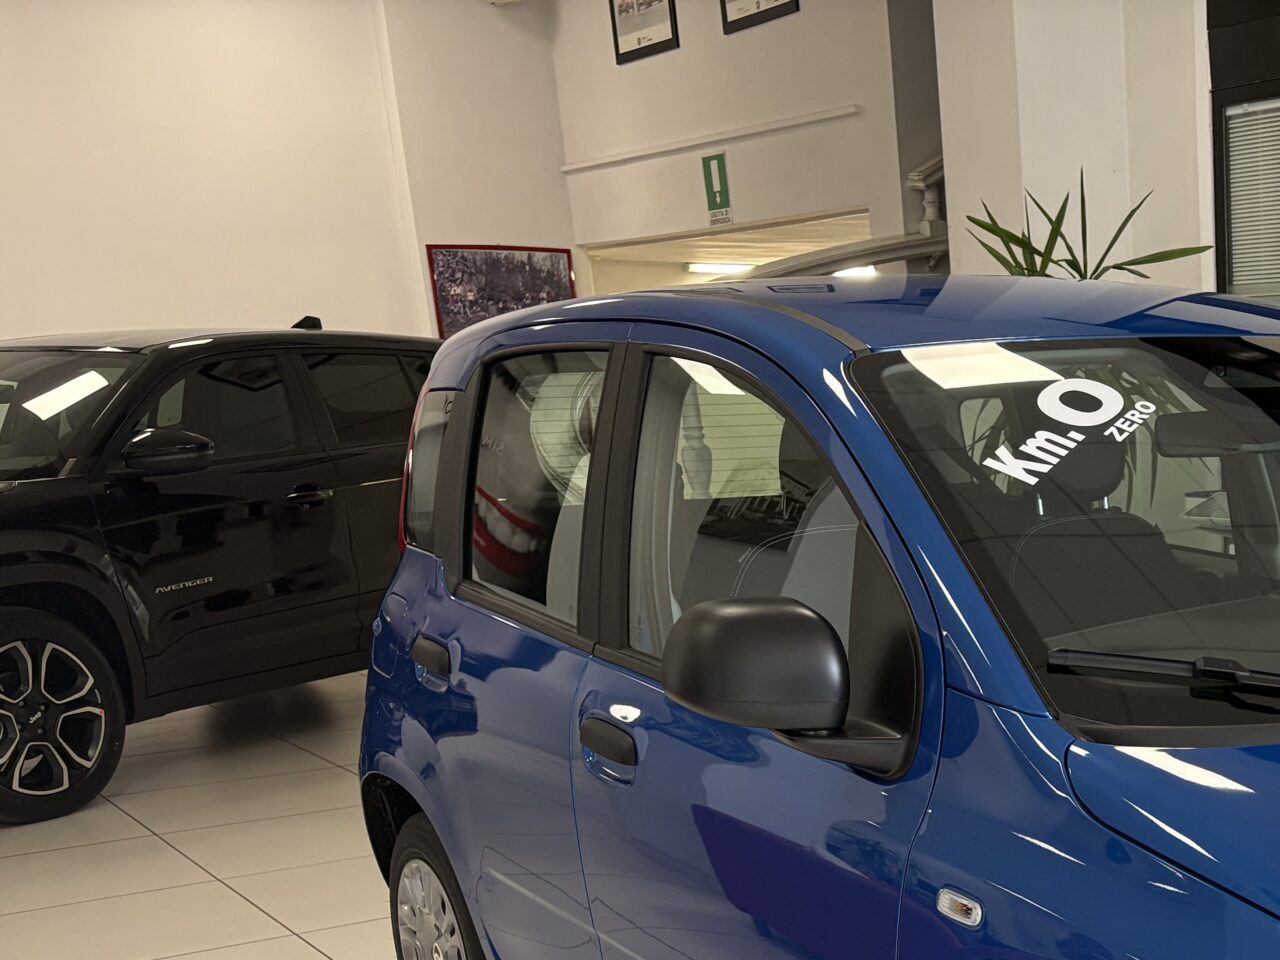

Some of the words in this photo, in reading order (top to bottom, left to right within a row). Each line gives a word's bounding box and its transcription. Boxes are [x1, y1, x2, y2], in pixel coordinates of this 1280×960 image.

[1102, 400, 1157, 443] ZERO
[981, 430, 1086, 486] Km.
[155, 576, 213, 594] AVENGER
